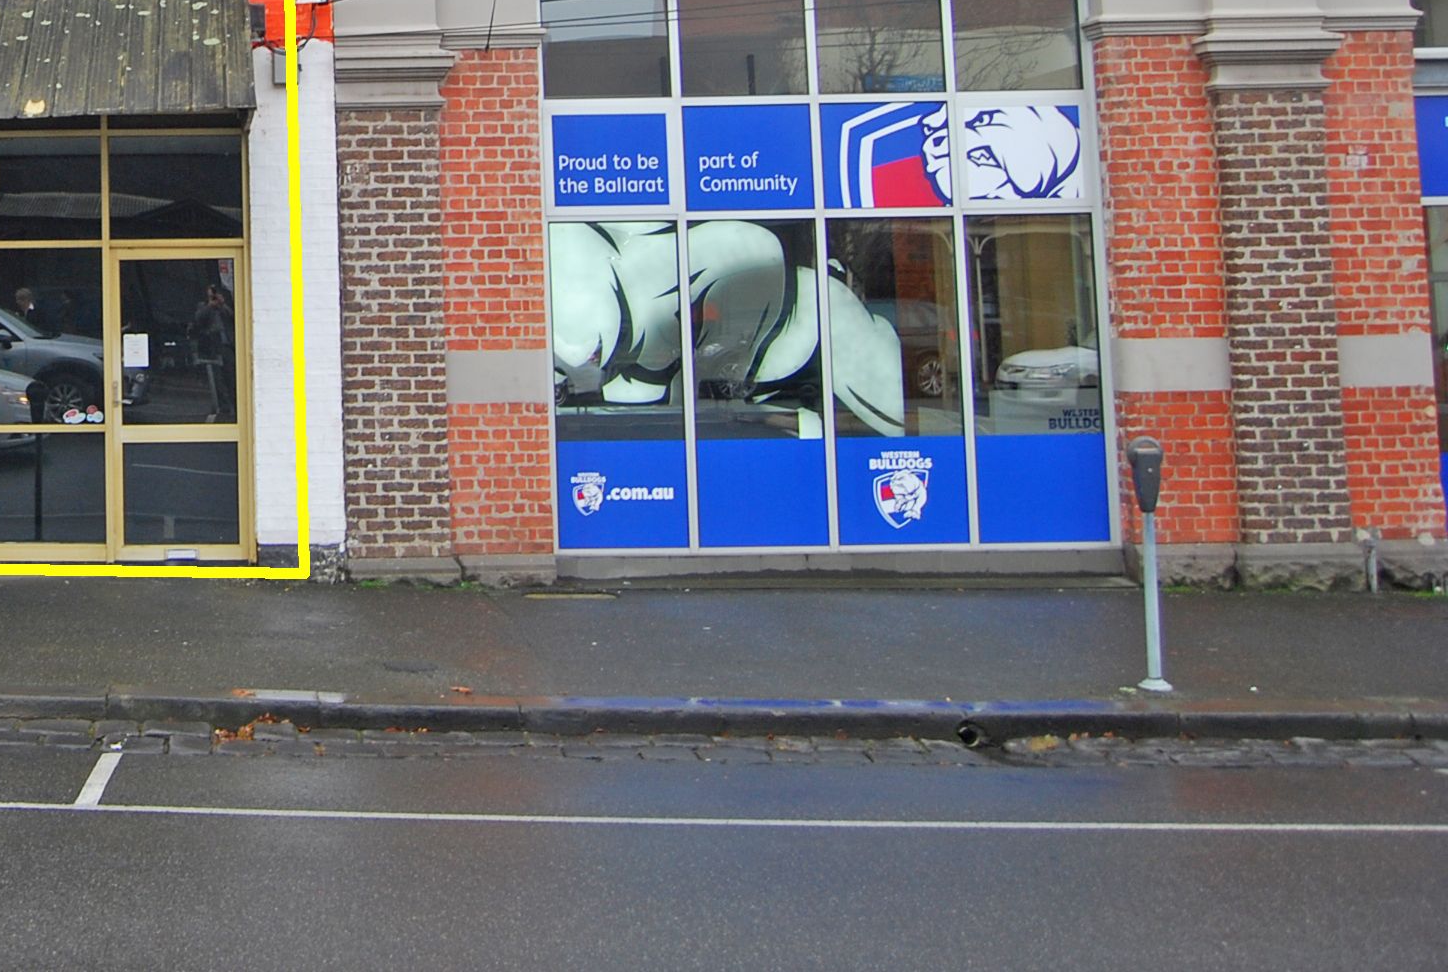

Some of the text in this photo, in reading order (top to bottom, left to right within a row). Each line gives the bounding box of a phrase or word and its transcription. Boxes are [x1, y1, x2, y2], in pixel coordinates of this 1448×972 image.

[558, 151, 759, 172] Proud to be part of
[558, 174, 798, 196] the Ballarat Community
[881, 451, 920, 459] WESTERN
[869, 458, 932, 470] BULLDOGS
[606, 487, 674, 500] .com.au
